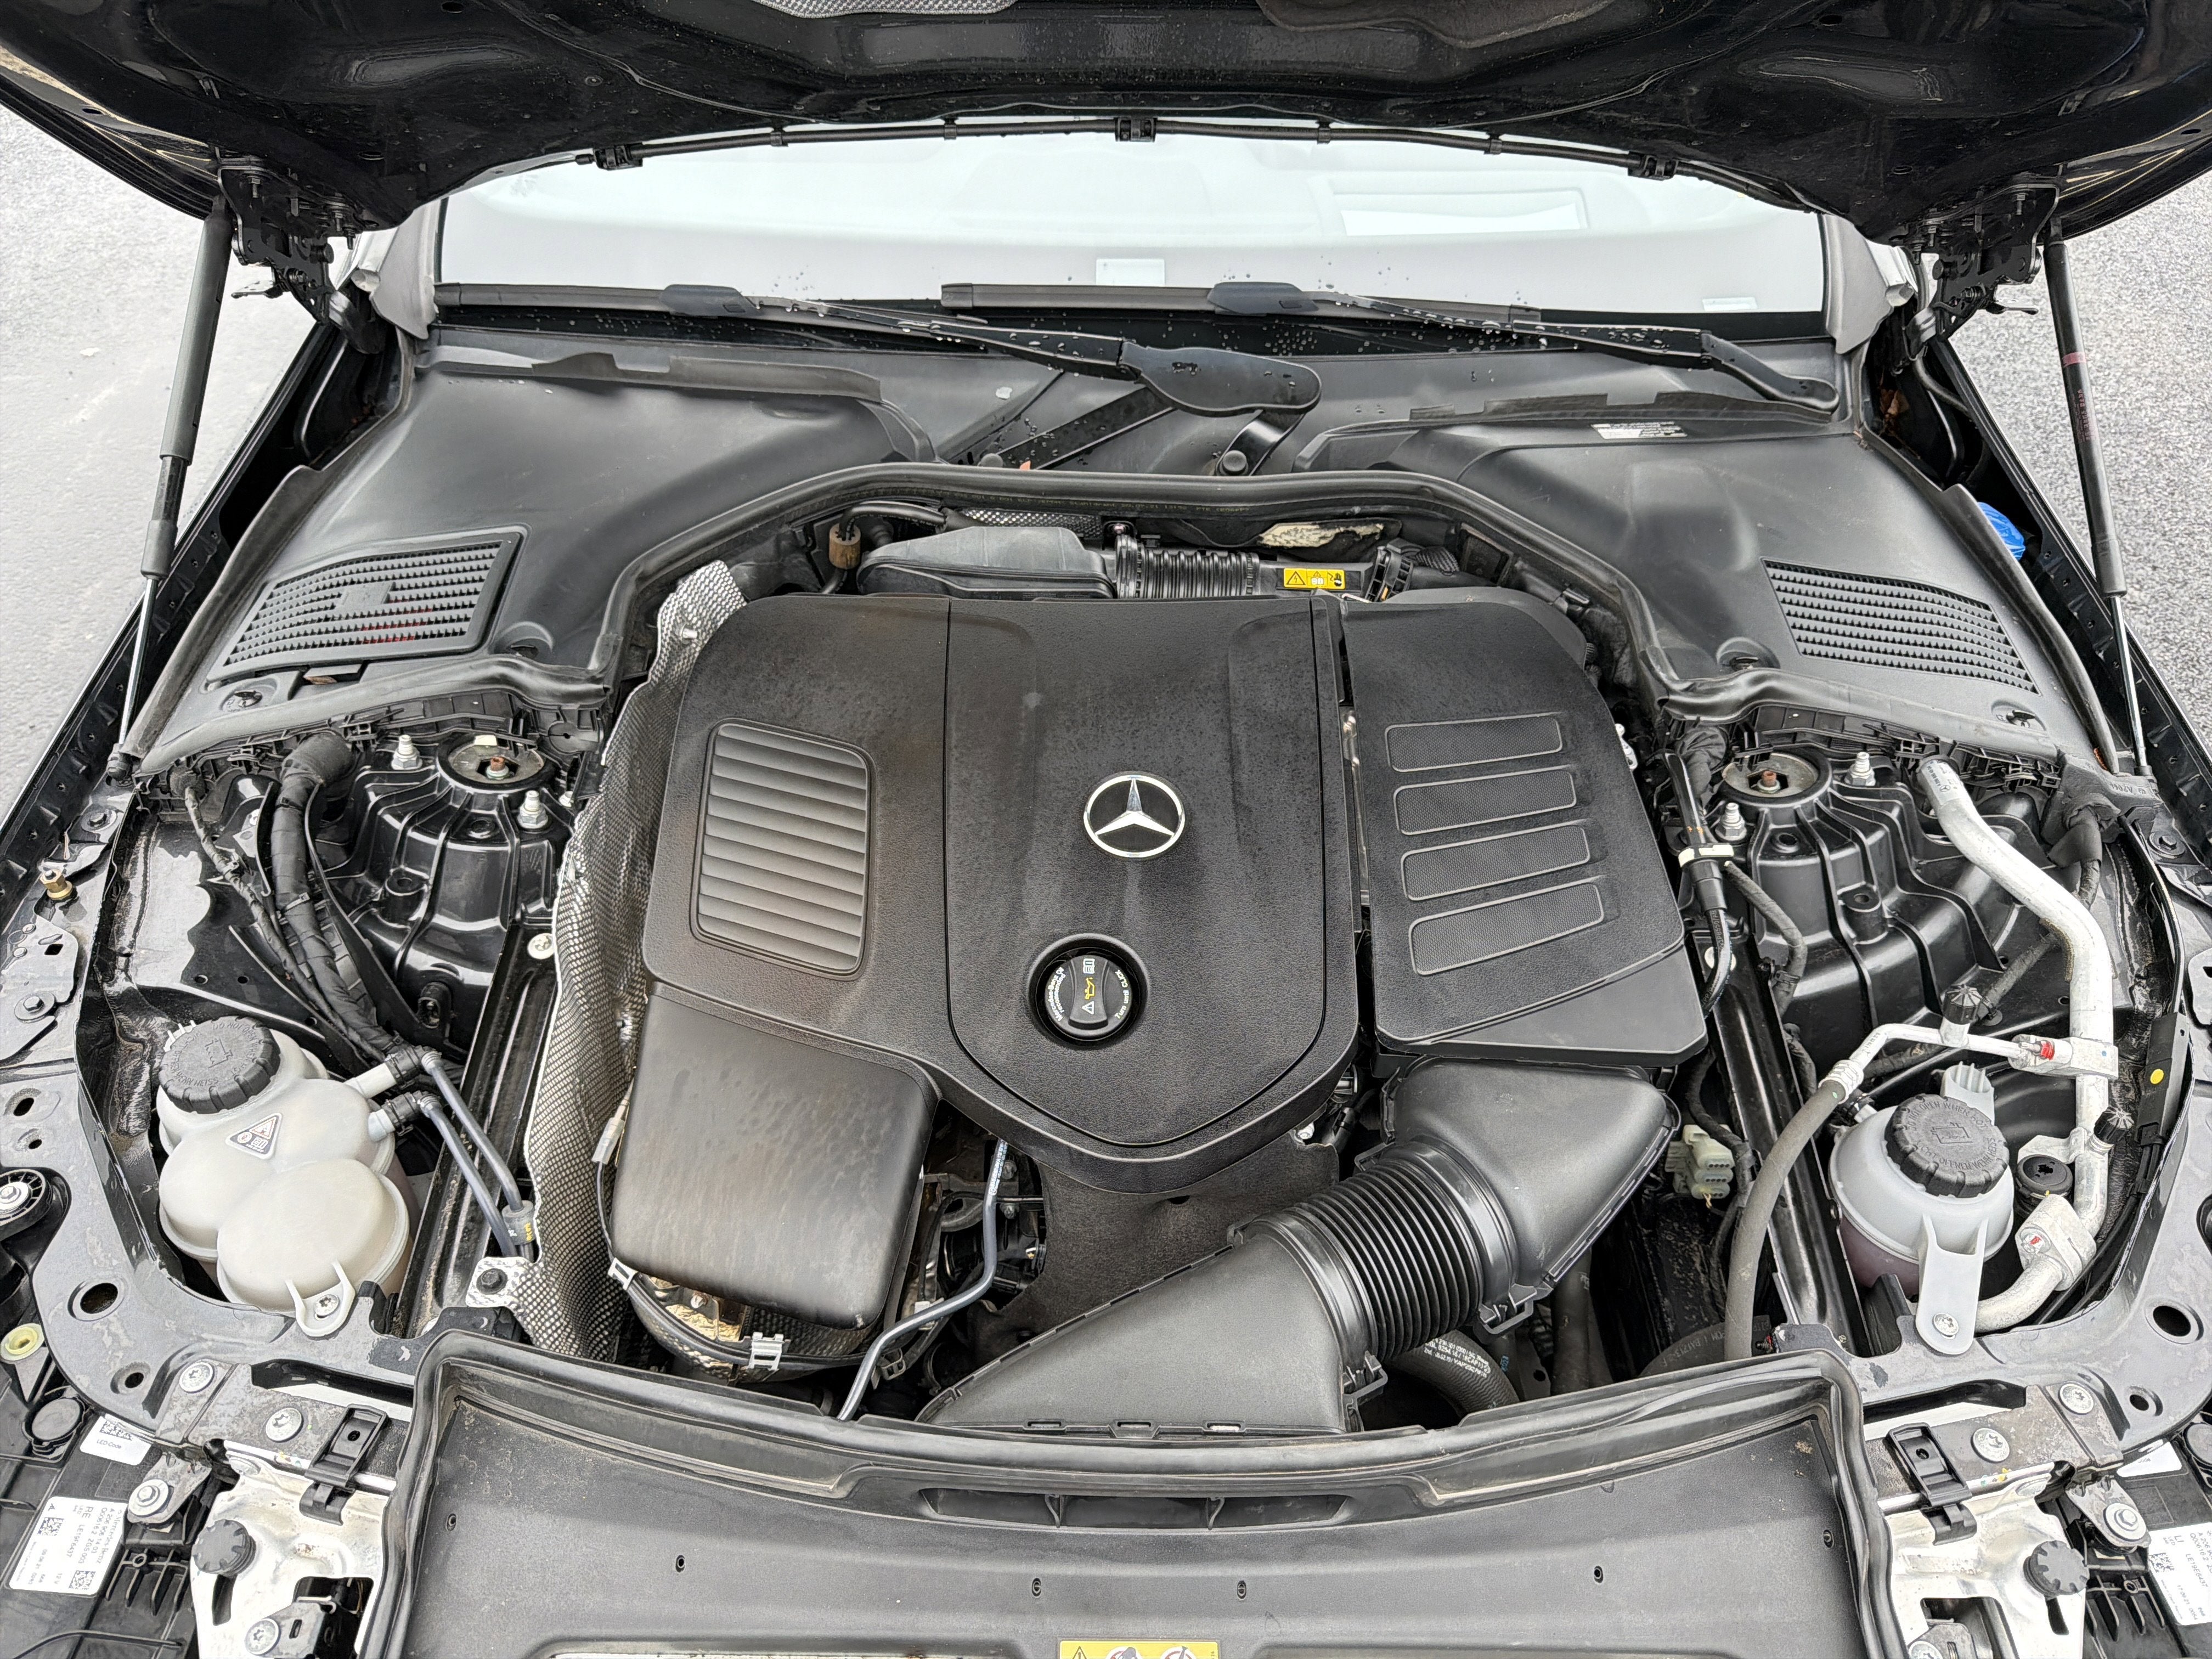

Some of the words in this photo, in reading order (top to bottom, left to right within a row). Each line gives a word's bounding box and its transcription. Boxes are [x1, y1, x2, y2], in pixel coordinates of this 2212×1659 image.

[1115, 969, 1128, 988] CLICK
[1048, 974, 1063, 1022] Mercedes-Benz
[1056, 967, 1064, 975] Oil
[1054, 973, 1066, 1013] recommended
[1114, 1005, 1127, 1019] Turn
[242, 1026, 258, 1041] OPEN
[246, 1041, 258, 1062] WHEN
[194, 1078, 219, 1087] HEISS
[1909, 1110, 1920, 1120] NOT
[1920, 1101, 1940, 1110] OPEN
[1943, 1102, 1970, 1116] WHEN
[1987, 1137, 1998, 1157] HEISS
[81, 1506, 94, 1519] RE
[2200, 1538, 2210, 1549] 206
